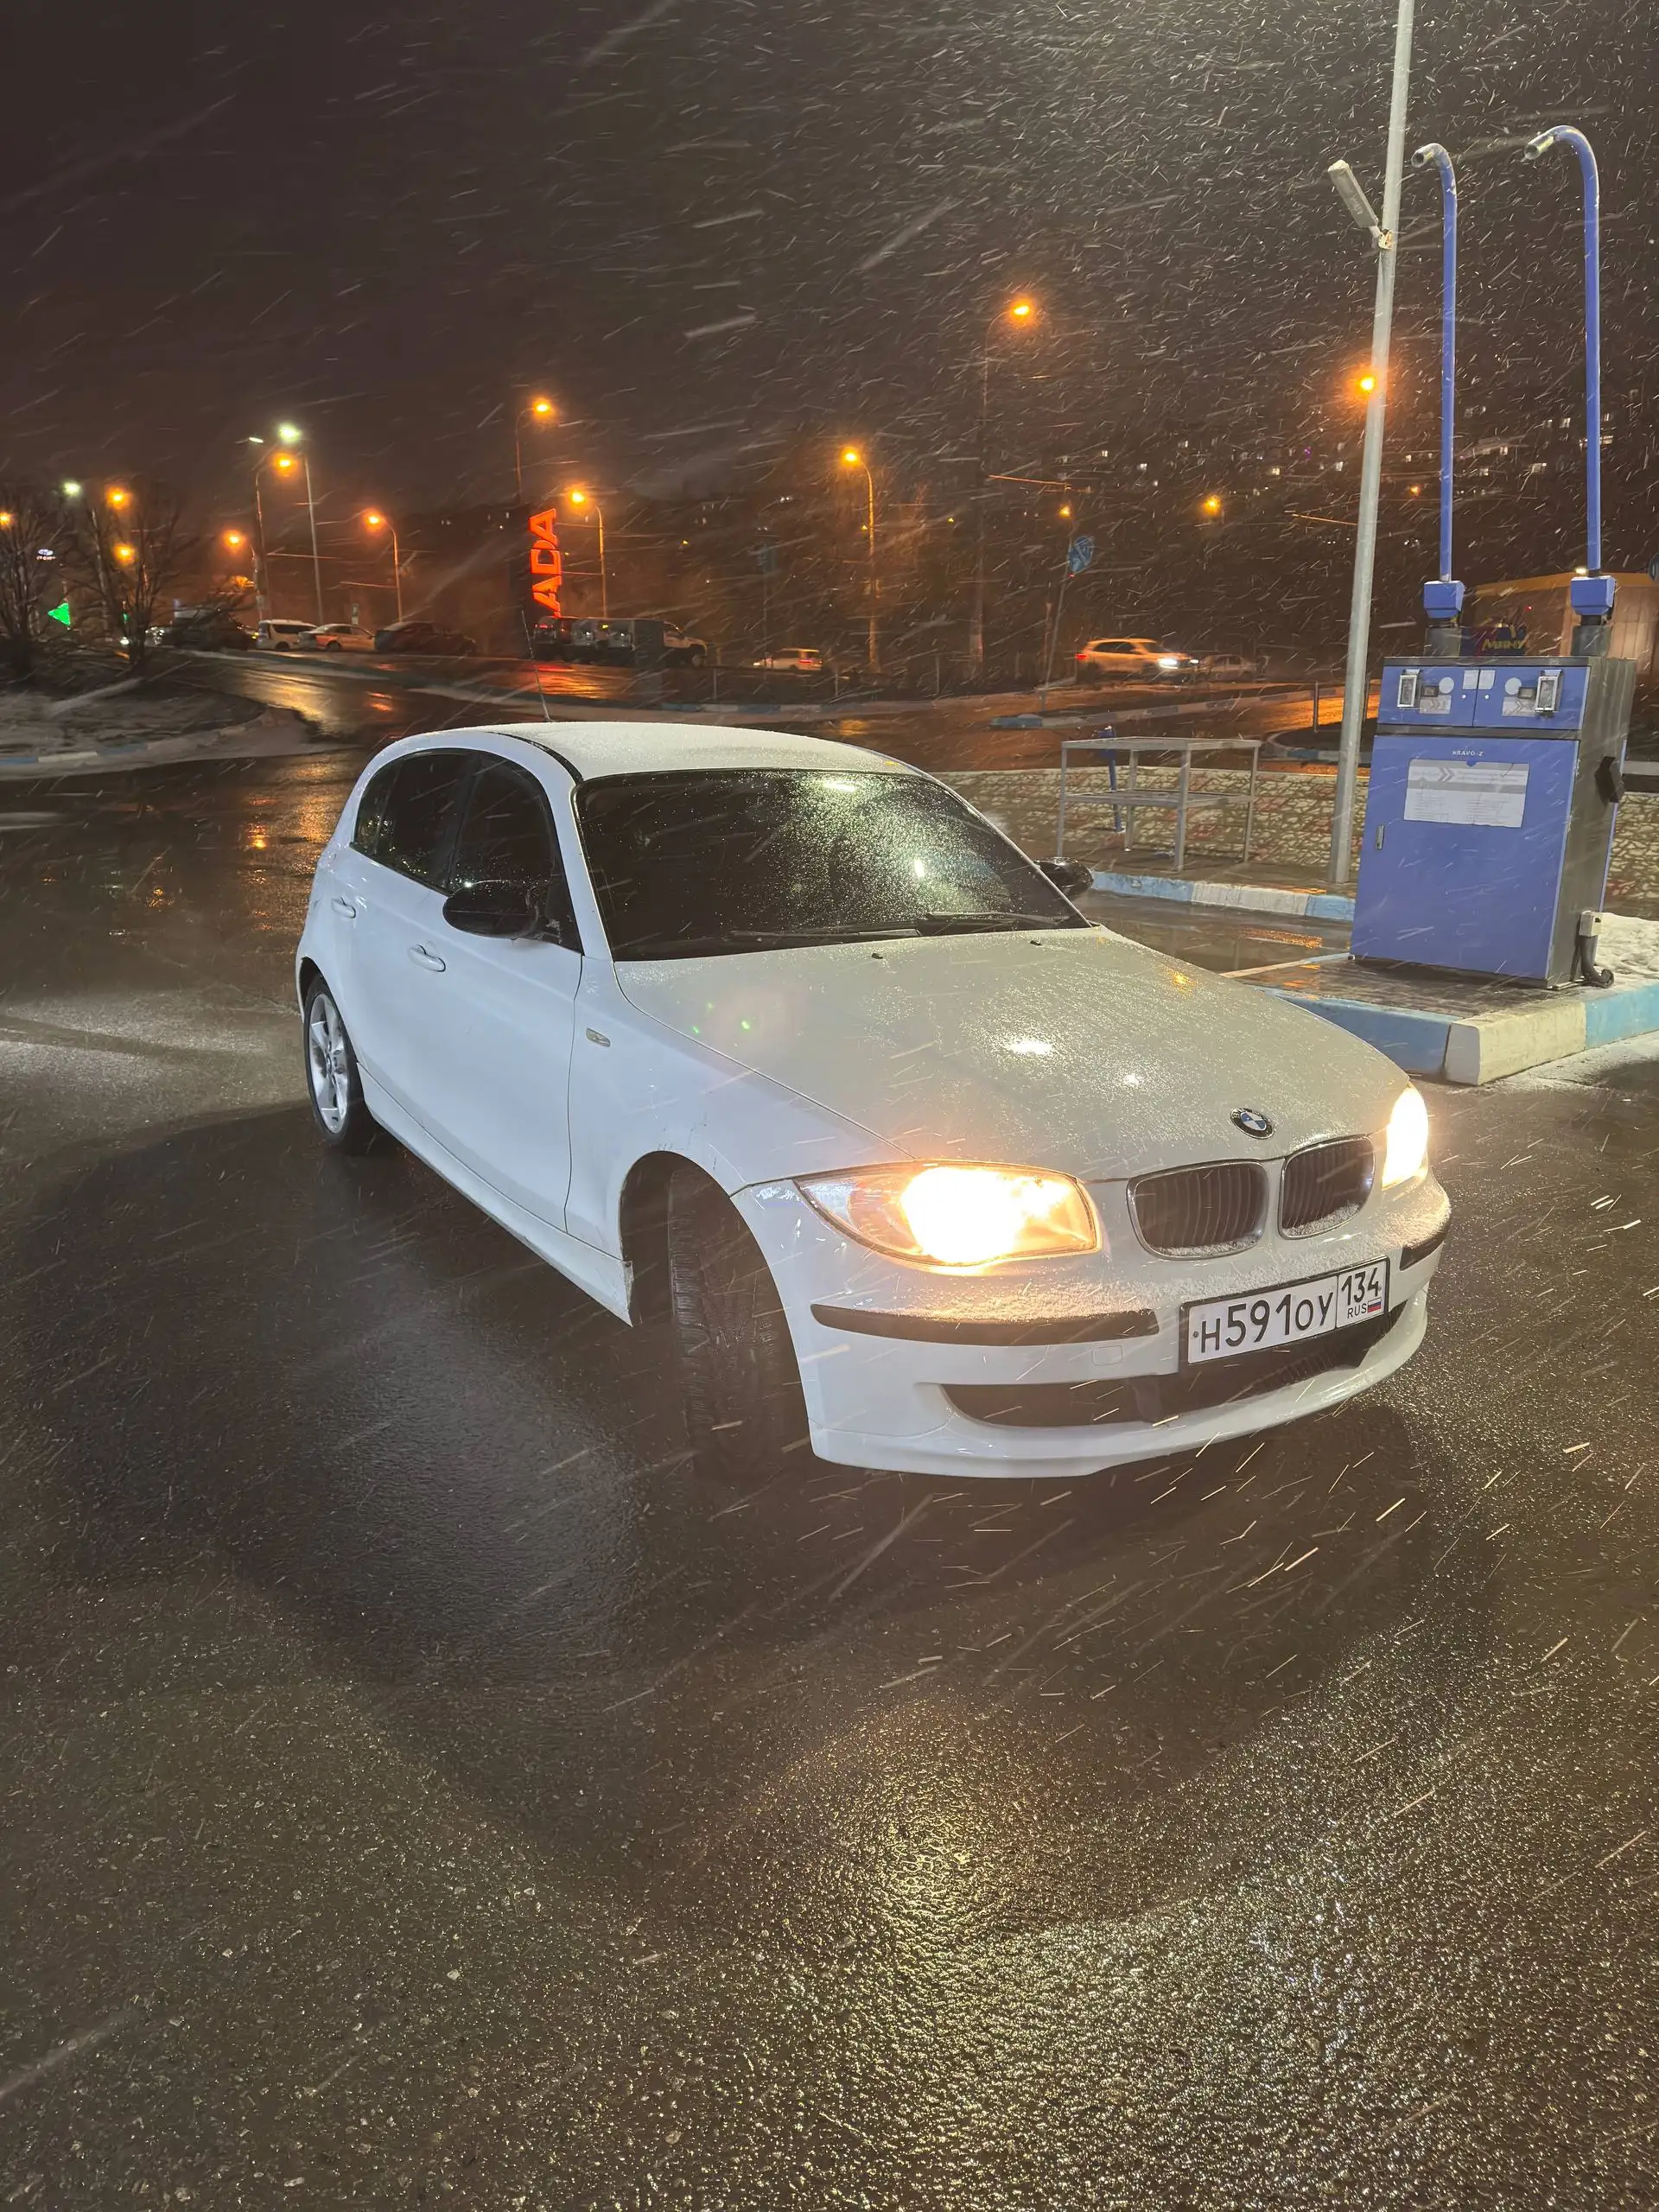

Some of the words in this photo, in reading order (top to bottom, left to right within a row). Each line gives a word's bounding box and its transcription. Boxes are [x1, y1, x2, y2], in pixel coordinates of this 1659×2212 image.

[529, 508, 562, 618] ADA
[1341, 1268, 1380, 1306] 134
[1347, 1303, 1367, 1319] RUS
